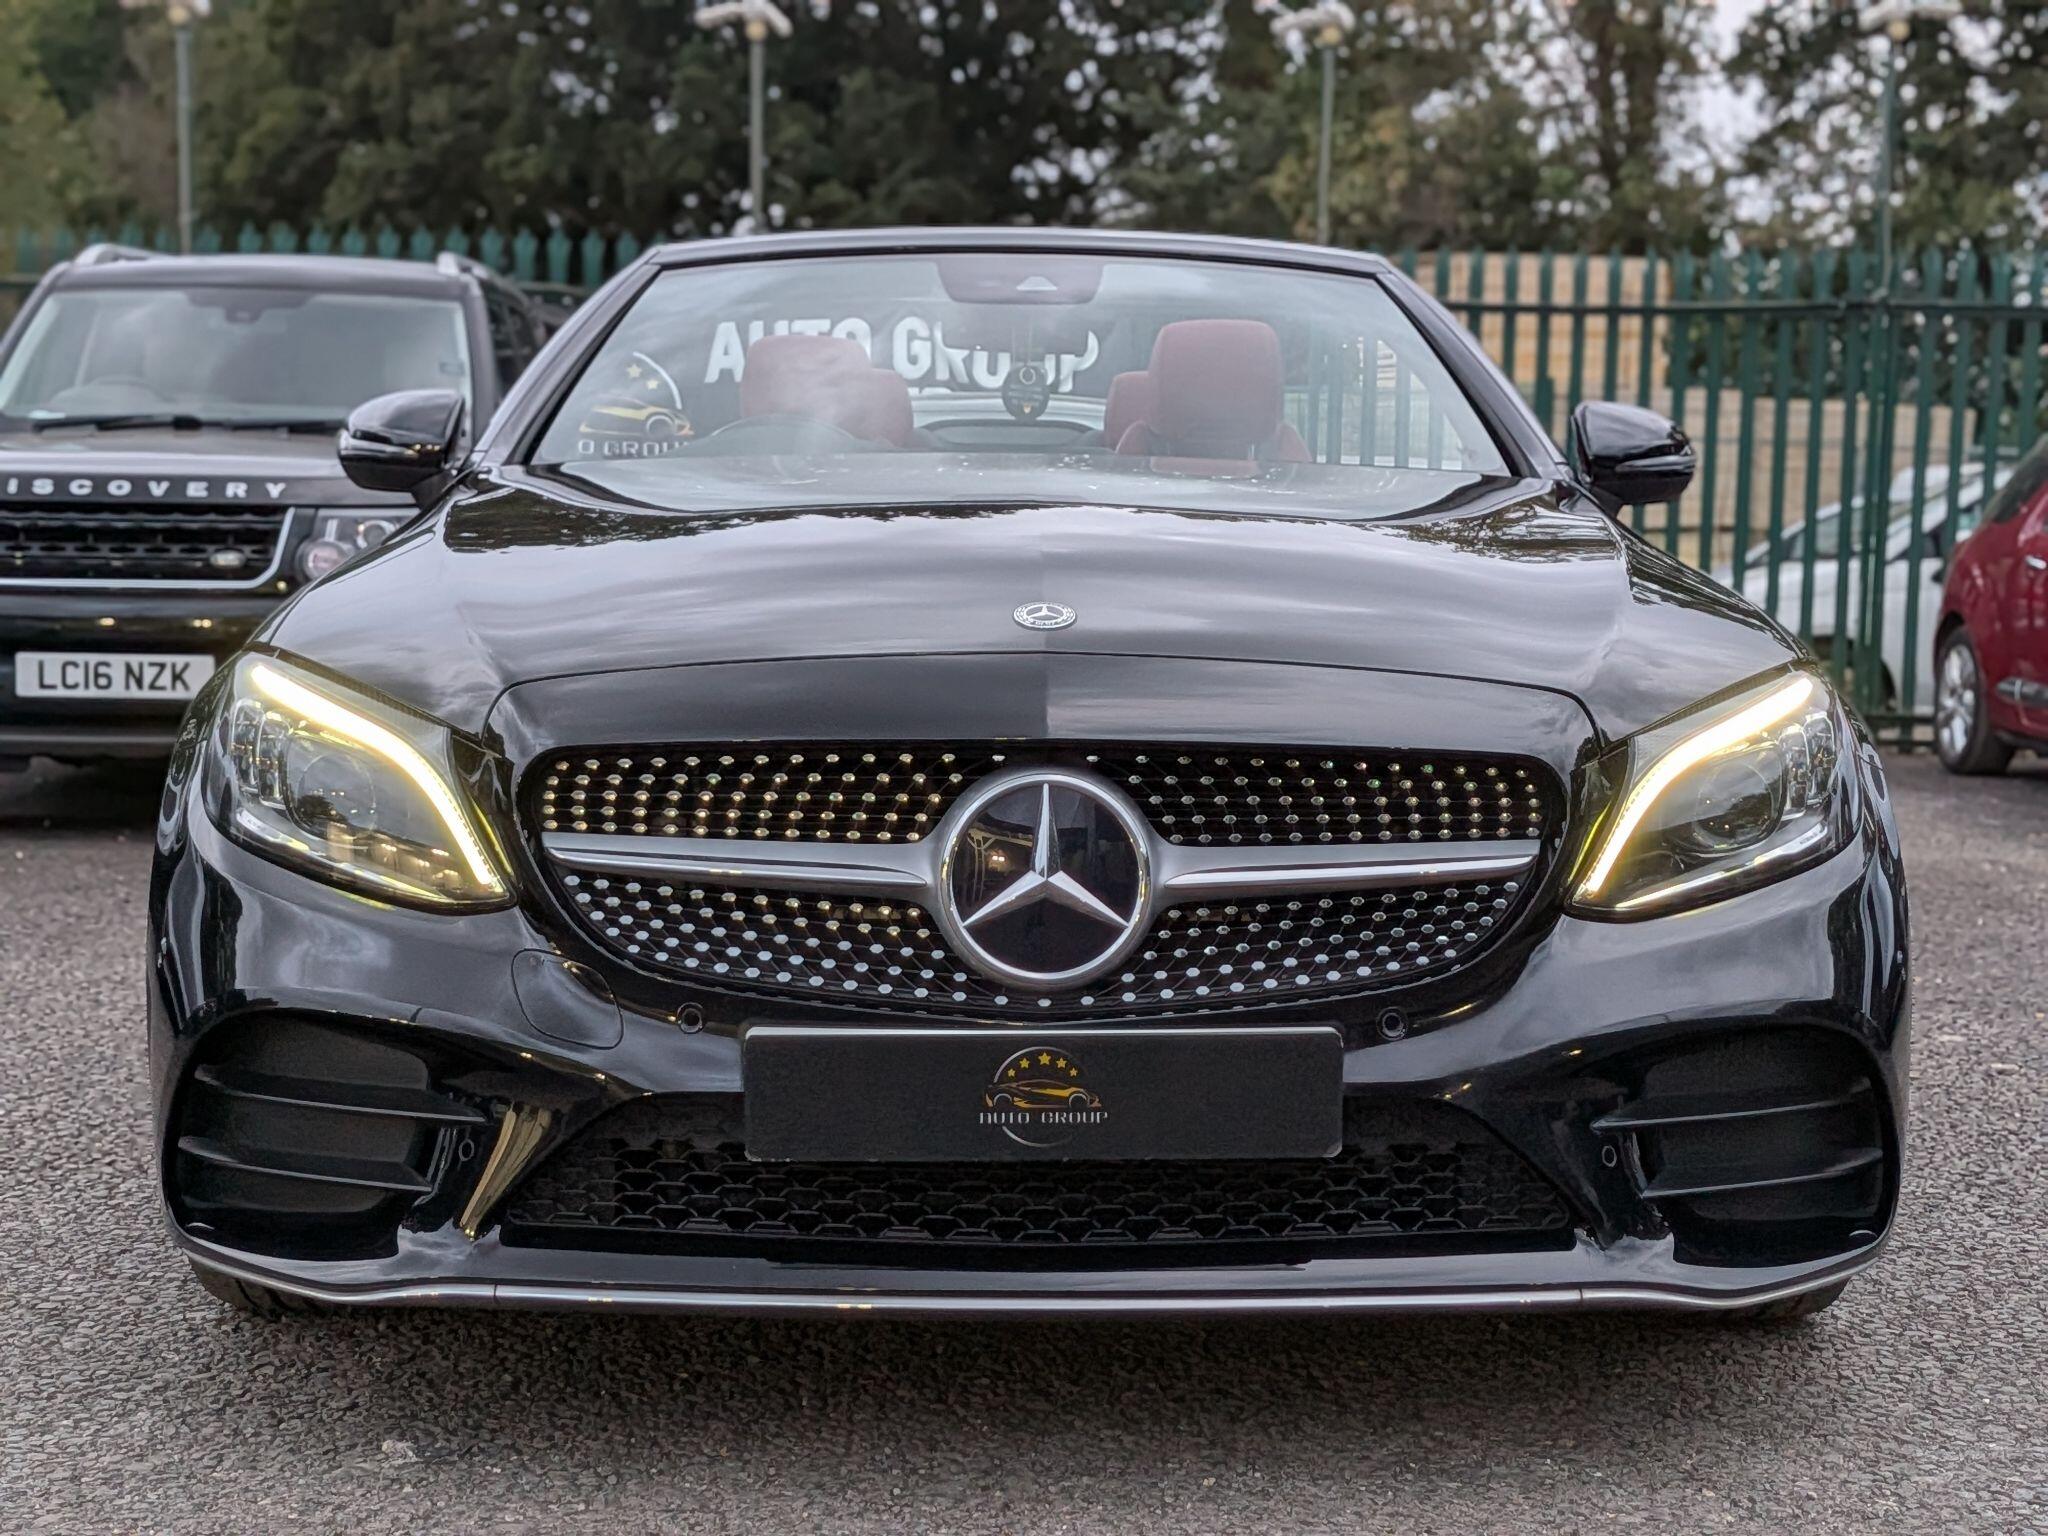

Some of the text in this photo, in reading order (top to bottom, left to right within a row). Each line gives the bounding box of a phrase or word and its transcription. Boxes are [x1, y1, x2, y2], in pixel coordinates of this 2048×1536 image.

[893, 316, 1099, 393] GROP
[603, 440, 688, 457] GROU
[6, 477, 287, 498] ISCOVERY
[38, 660, 190, 691] LC16 NZK
[979, 1111, 1108, 1125] AUTO GROUP
